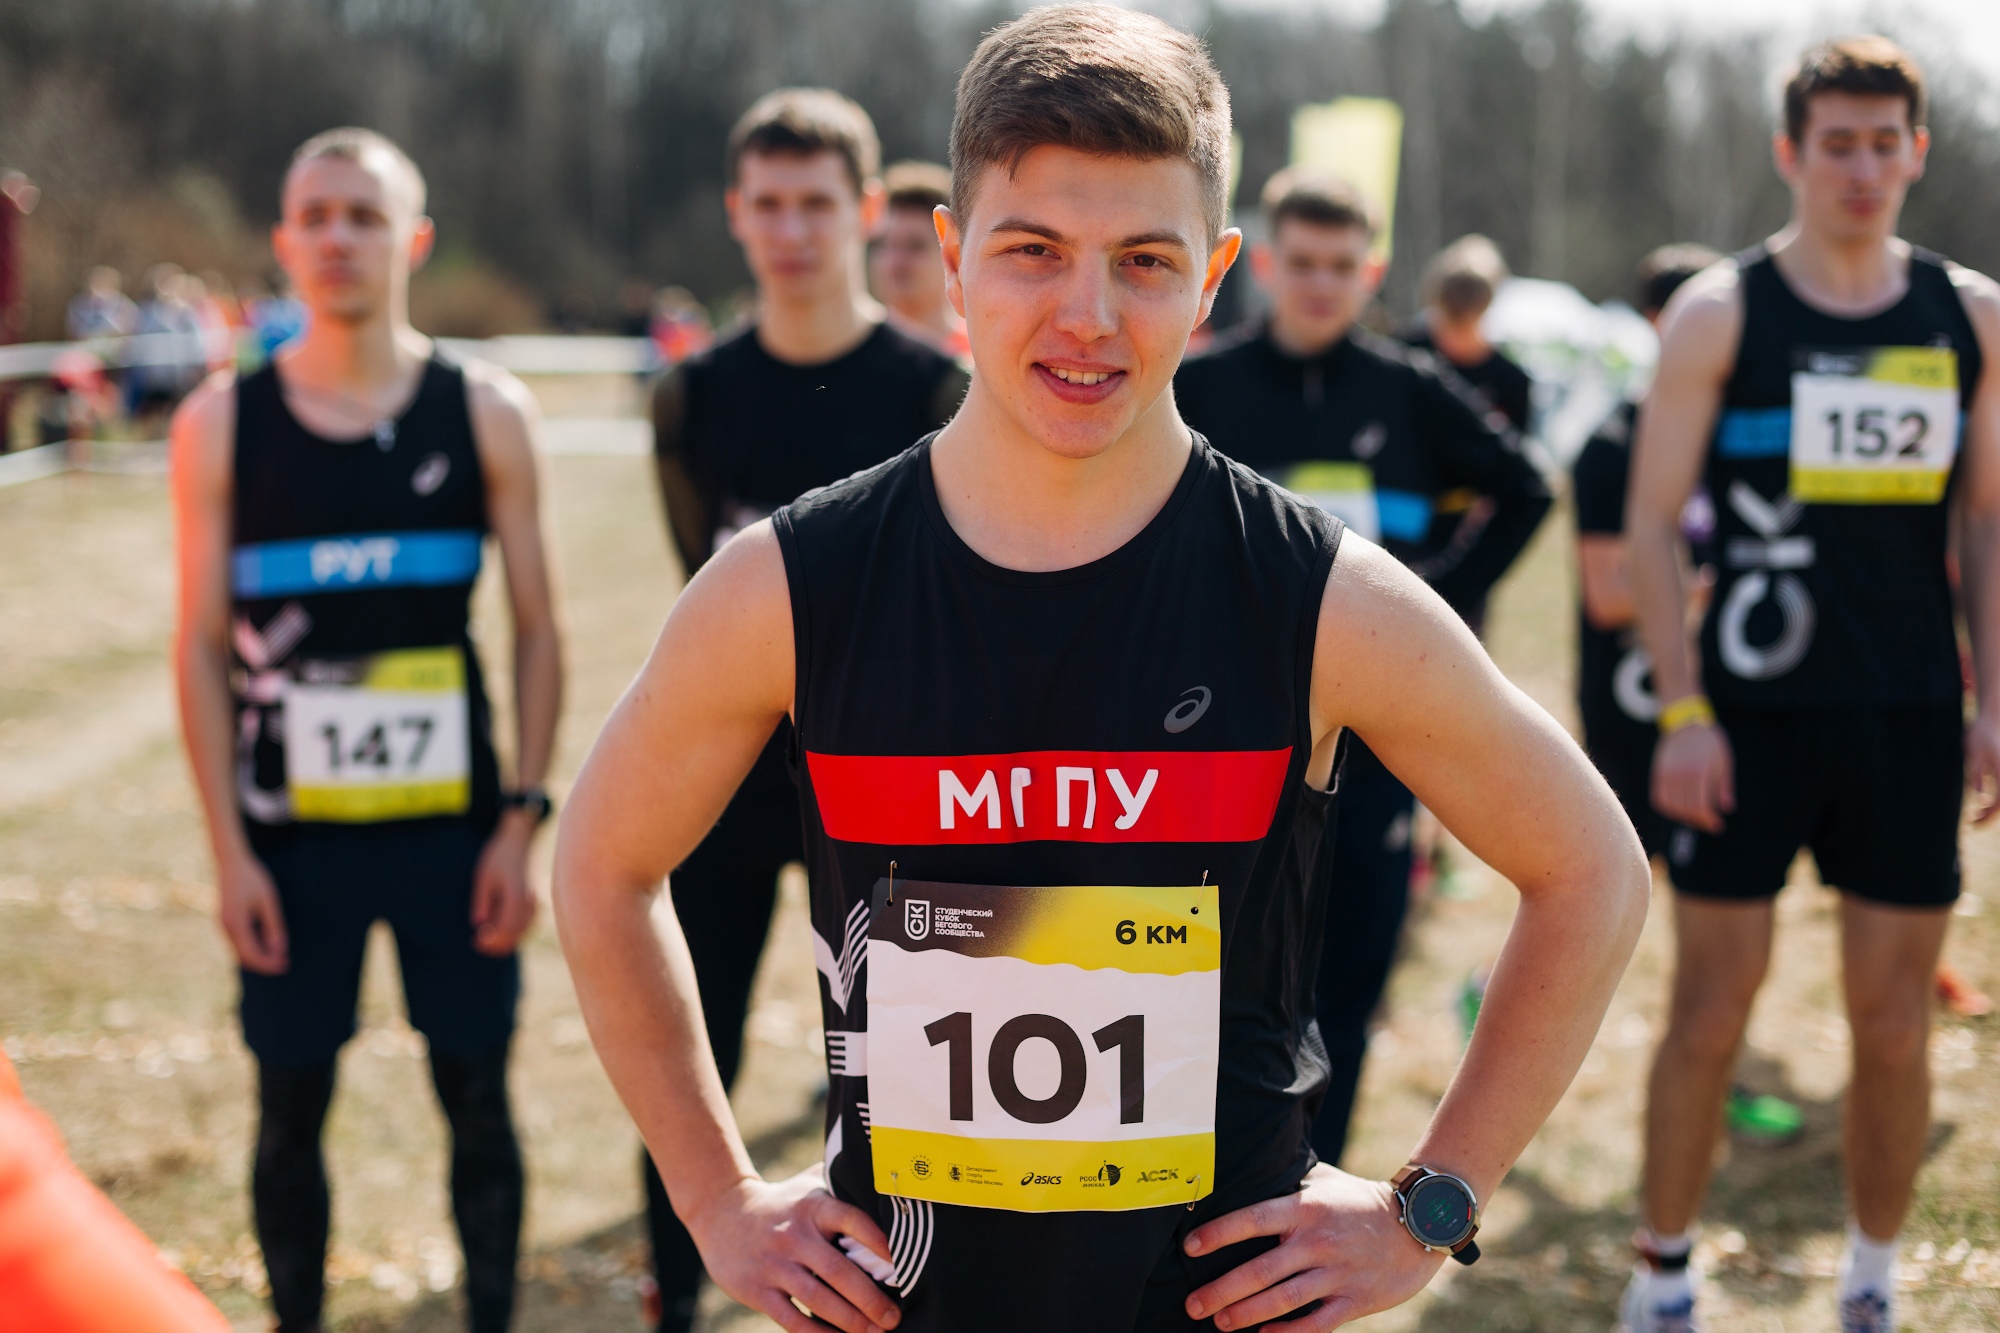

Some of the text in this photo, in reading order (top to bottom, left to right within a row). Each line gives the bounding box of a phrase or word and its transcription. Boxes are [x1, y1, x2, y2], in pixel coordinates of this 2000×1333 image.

[1825, 406, 1931, 459] 152
[309, 538, 399, 586] РУТ
[317, 715, 436, 775] 147
[935, 907, 993, 917] СТУДЕНЧЕСКИЙ
[935, 921, 973, 930] БЕГОВОГО
[935, 928, 985, 938] СООБЩЕСТВА
[1115, 919, 1137, 945] 6
[923, 1011, 1145, 1125] 101
